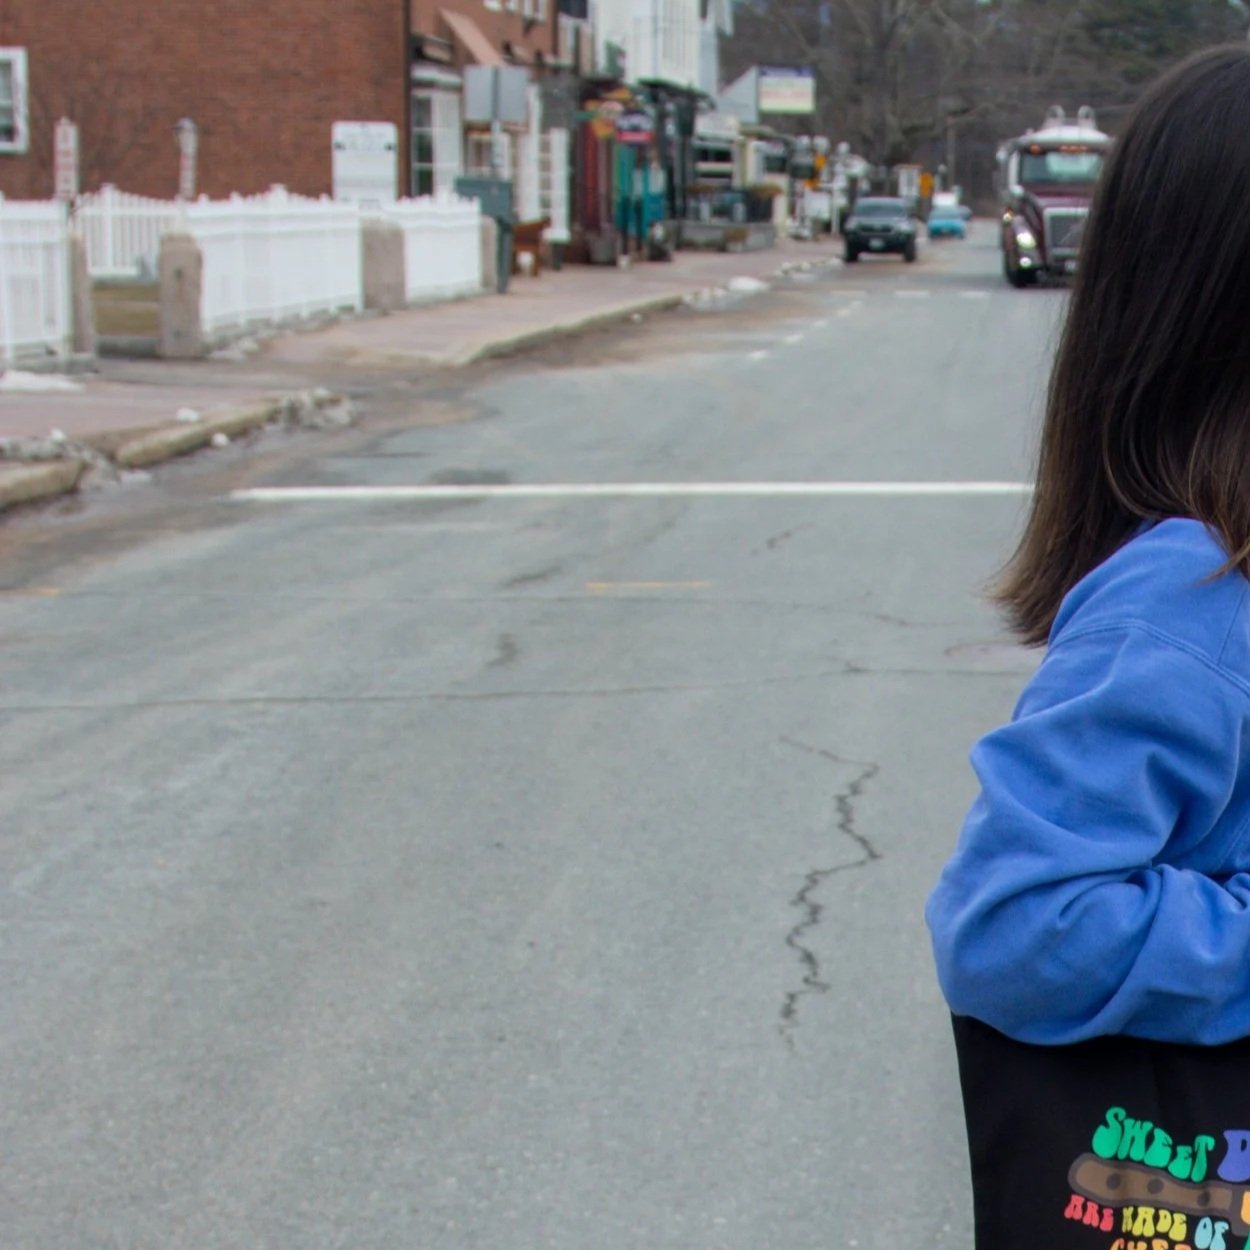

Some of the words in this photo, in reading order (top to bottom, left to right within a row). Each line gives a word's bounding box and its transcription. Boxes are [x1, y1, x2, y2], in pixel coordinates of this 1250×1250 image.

[1092, 1106, 1215, 1182] SWEET
[1064, 1194, 1114, 1232] ARE
[1122, 1206, 1187, 1241] MADE
